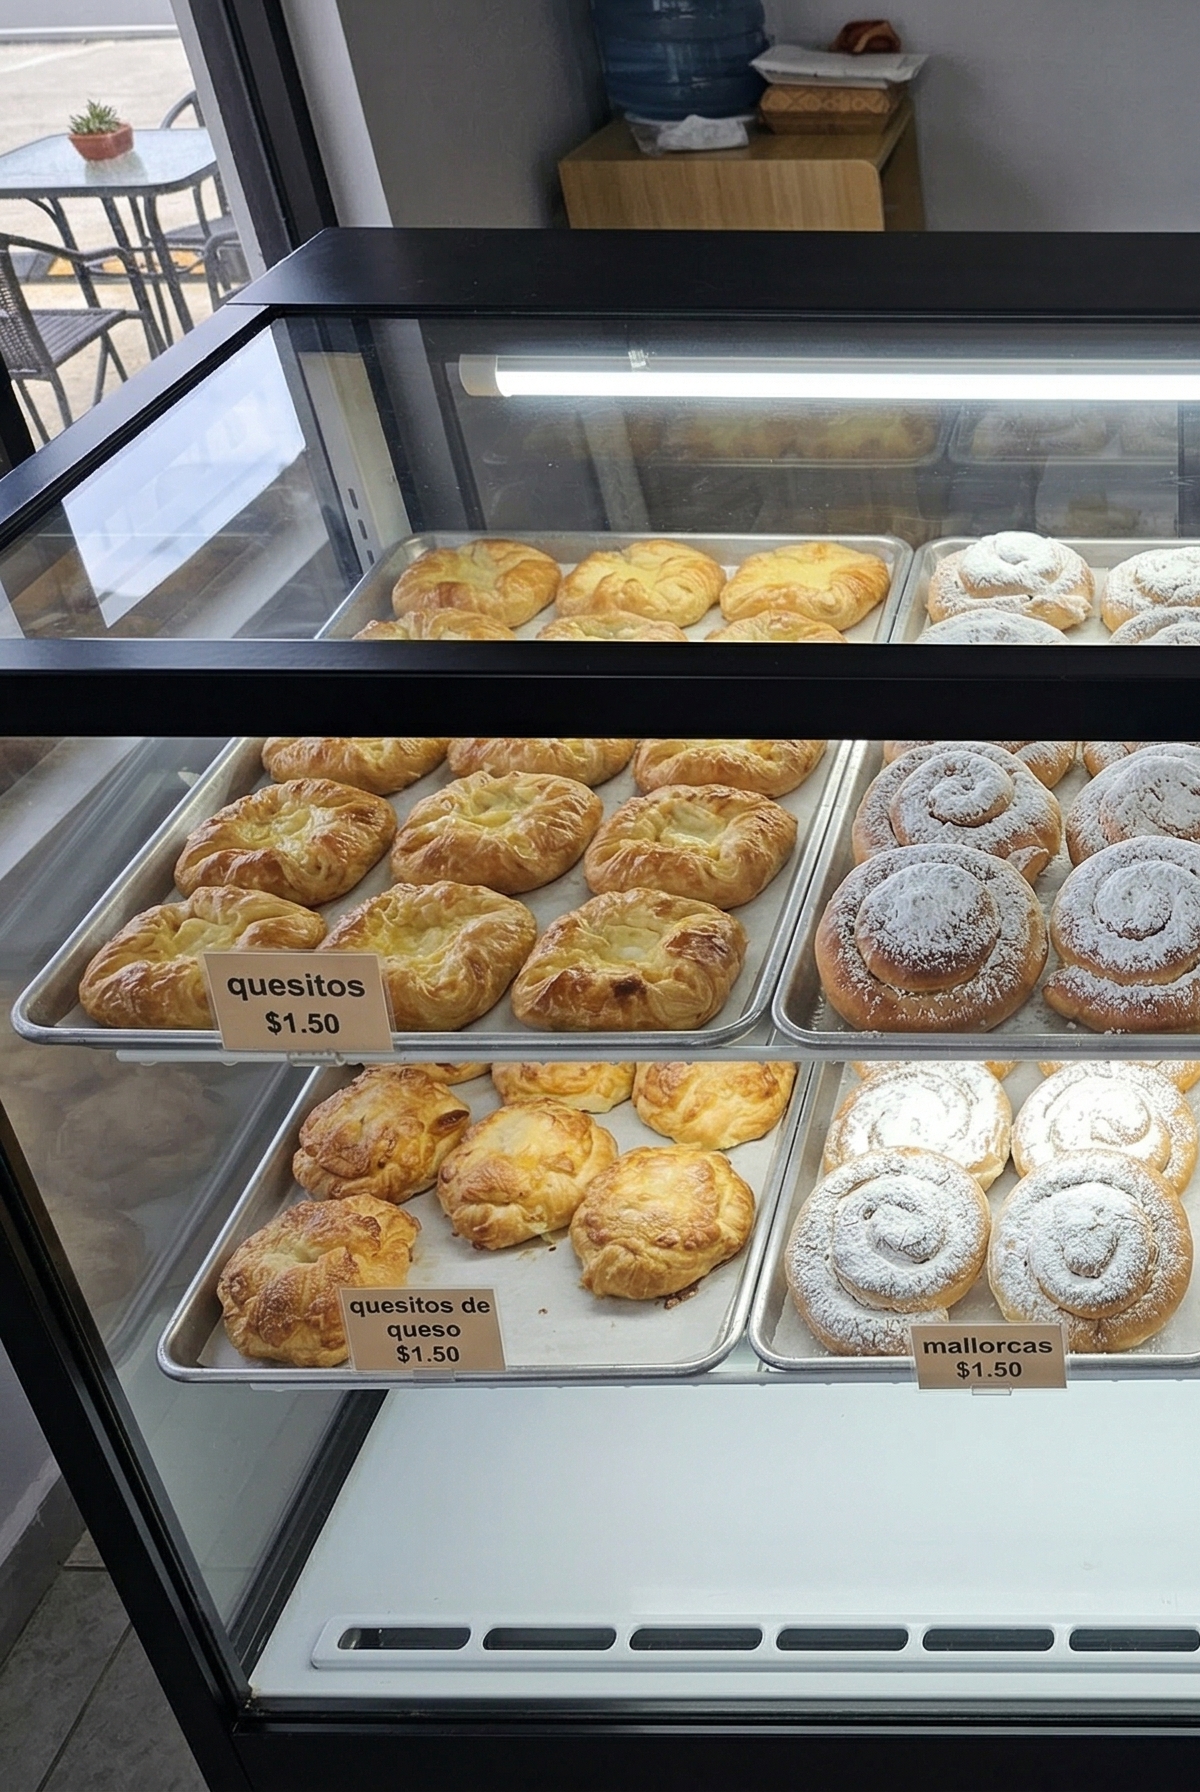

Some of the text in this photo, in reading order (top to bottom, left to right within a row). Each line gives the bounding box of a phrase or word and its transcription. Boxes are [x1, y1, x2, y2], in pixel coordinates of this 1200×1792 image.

[227, 973, 366, 1002] quesitos
[265, 1010, 340, 1036] $1.50
[349, 1296, 490, 1318] quesitos de
[387, 1323, 461, 1341] queso
[396, 1344, 460, 1364] $1.50
[923, 1337, 1053, 1354] mallorcas
[956, 1360, 1022, 1380] $1.50
